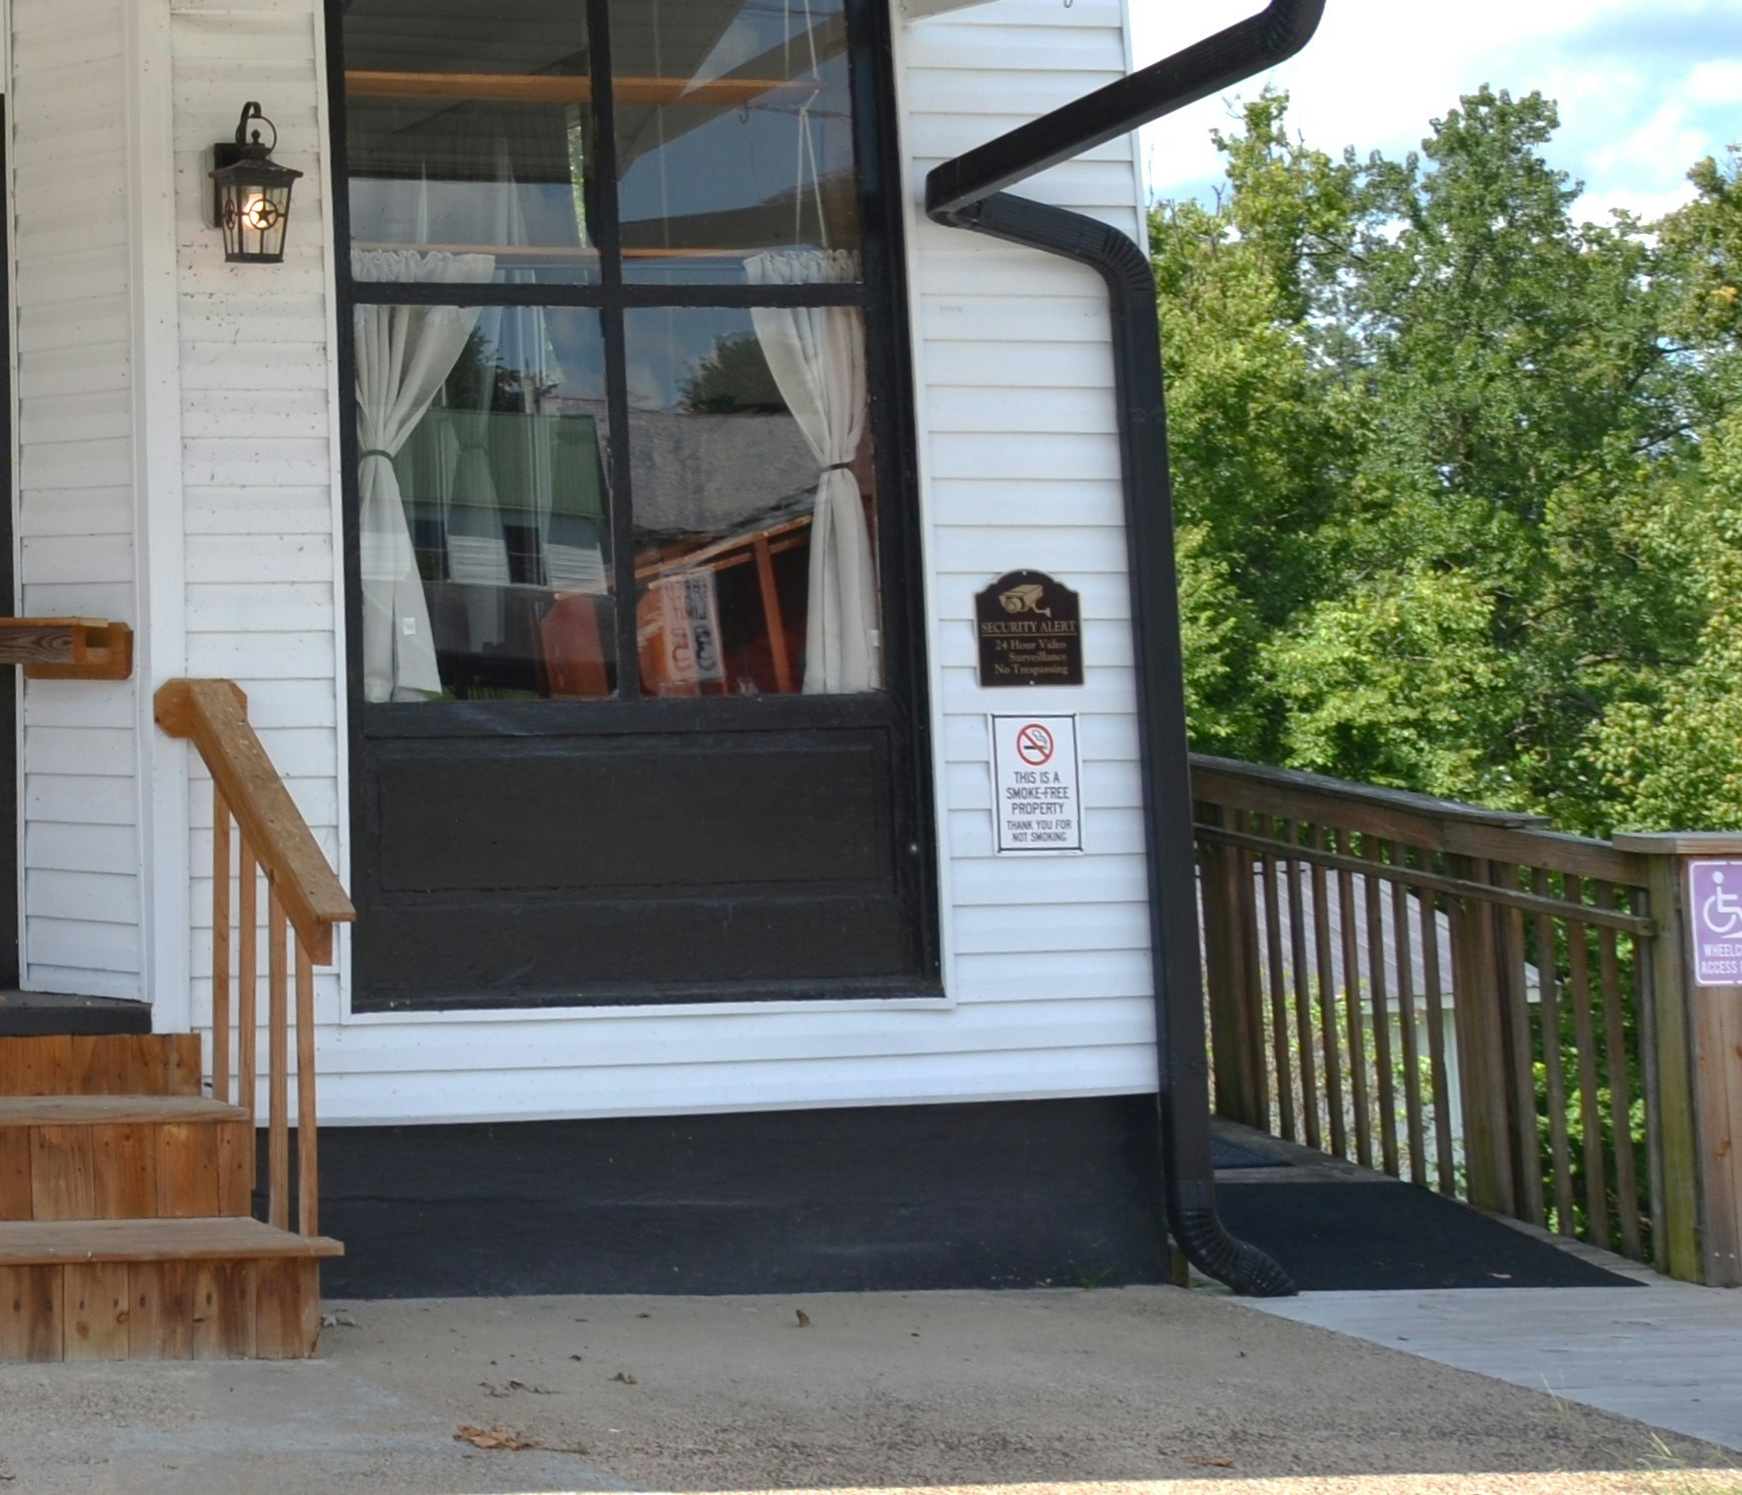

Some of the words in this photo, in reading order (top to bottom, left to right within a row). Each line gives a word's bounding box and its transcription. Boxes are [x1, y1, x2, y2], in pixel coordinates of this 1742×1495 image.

[981, 621, 1037, 633] SECURITY
[1040, 620, 1076, 632] ALERT
[995, 640, 1009, 651] 24
[1010, 639, 1036, 650] Hour
[1038, 639, 1067, 650] Video
[1009, 651, 1067, 662] Surveillance
[994, 664, 1010, 674] No
[1012, 664, 1069, 676] Trespassing
[1014, 771, 1037, 784] THIS
[1040, 771, 1050, 784] IS
[1052, 771, 1061, 784] A
[1006, 786, 1070, 800] SMOKE-FREE
[1011, 802, 1064, 815] PROPERTY
[1006, 820, 1033, 830] THANK
[1036, 820, 1053, 830] YOU
[1056, 819, 1072, 829] FOR
[1012, 832, 1028, 842] NOT
[1031, 832, 1067, 842] SMOKING
[1701, 961, 1738, 974] ACCESS
